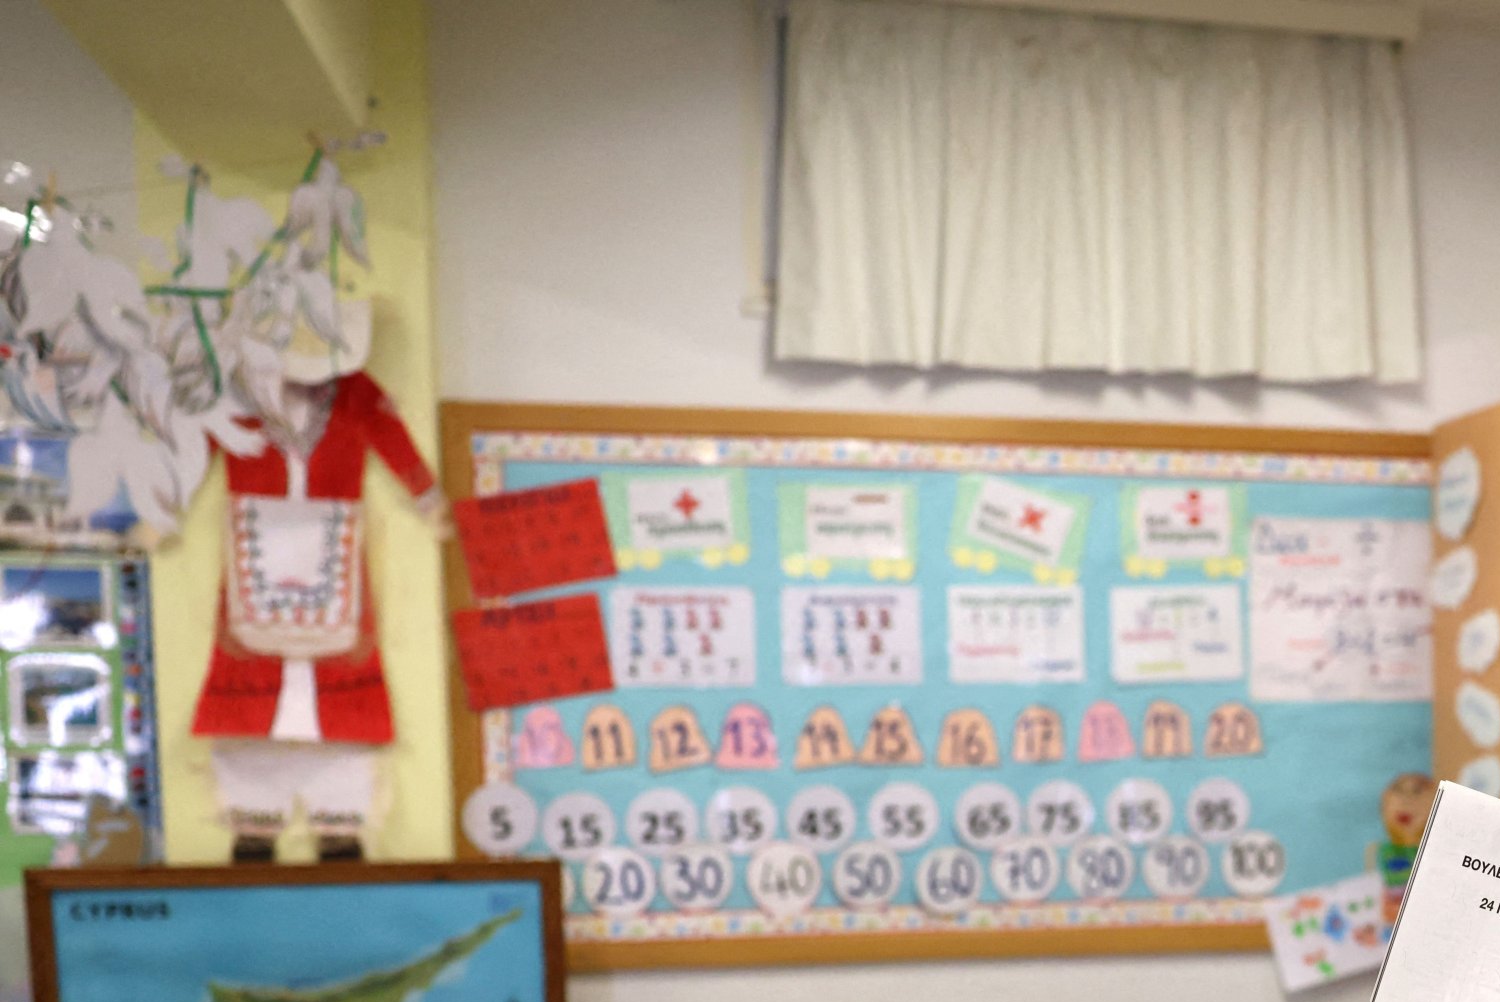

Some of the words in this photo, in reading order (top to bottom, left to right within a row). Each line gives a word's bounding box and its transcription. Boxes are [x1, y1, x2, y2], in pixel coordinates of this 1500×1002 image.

[657, 720, 700, 760] 12
[726, 718, 769, 760] 13
[950, 721, 987, 766] 16
[489, 805, 513, 841] 5
[559, 813, 603, 848] 15
[640, 811, 686, 845] 25
[720, 808, 764, 843] 35
[799, 807, 843, 841] 45
[882, 803, 925, 838] 55
[967, 801, 1013, 839] 65
[1038, 801, 1081, 834] 75
[596, 859, 646, 905] 20
[674, 855, 724, 901] 30
[760, 856, 816, 897] 40
[844, 852, 893, 898] 50
[927, 852, 976, 903] 60
[1230, 840, 1286, 879] 100
[68, 902, 170, 921] CYPRUS
[1479, 897, 1495, 912] 24
